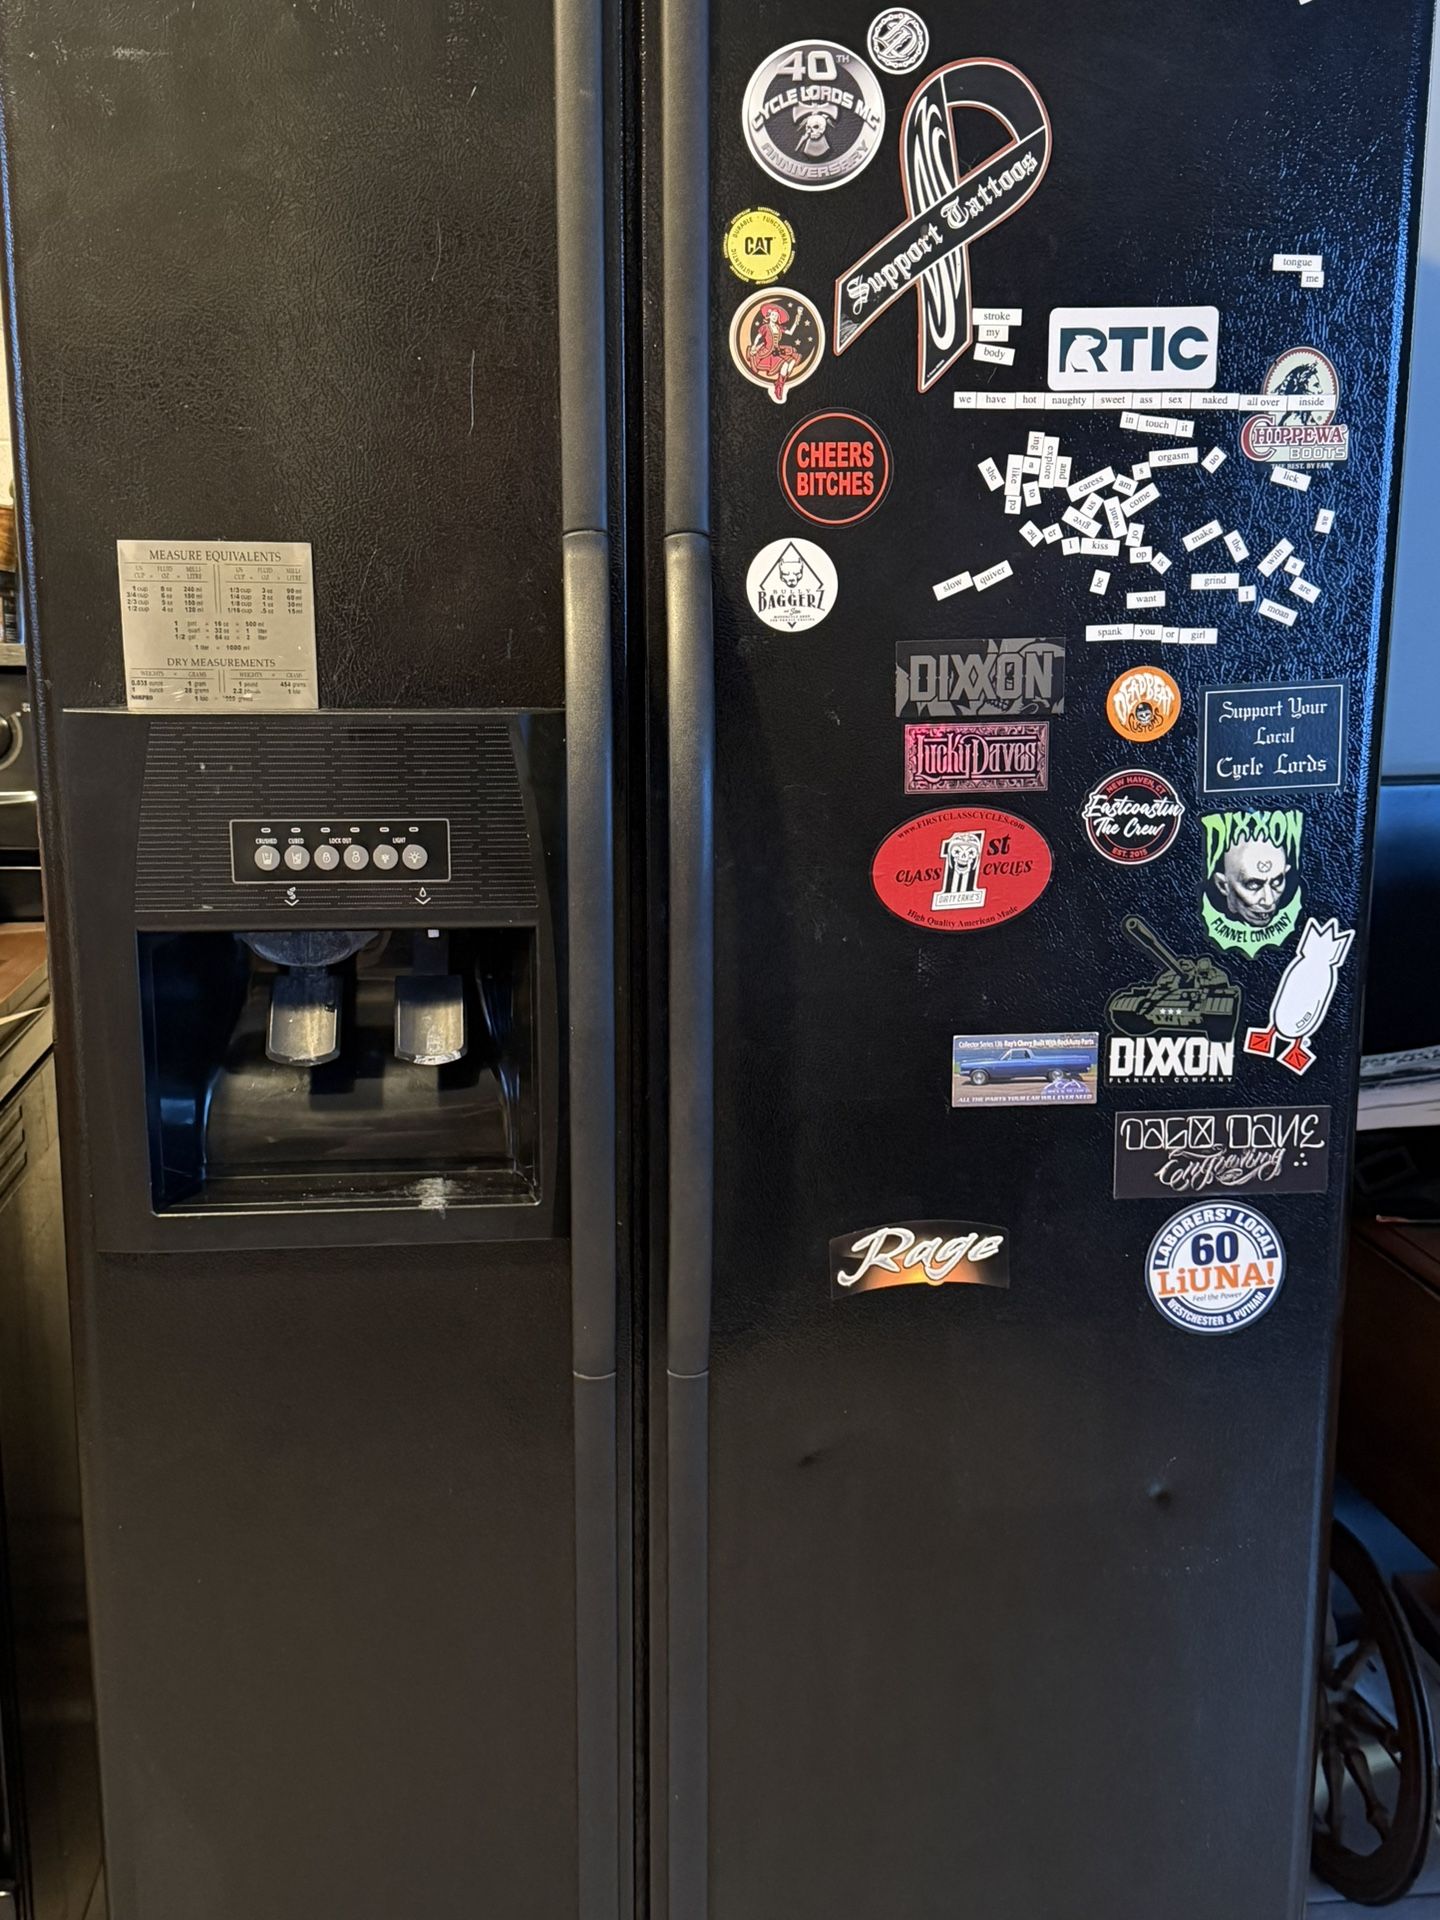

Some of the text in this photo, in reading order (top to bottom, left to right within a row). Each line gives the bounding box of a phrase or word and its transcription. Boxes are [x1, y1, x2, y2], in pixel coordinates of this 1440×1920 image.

[751, 85, 880, 131] CYCLE LORDS MC
[762, 139, 869, 178] ANNIVERSARY
[733, 217, 753, 238] DURABLE
[763, 215, 788, 245] FUNCTIONAL
[847, 151, 1039, 315] Support Tattoos
[745, 237, 773, 255] CAT
[1283, 258, 1313, 269] tongue
[984, 311, 1011, 321] stroke
[986, 329, 1000, 338] my
[984, 348, 1006, 360] body
[1059, 326, 1209, 373] RTIC
[959, 396, 972, 404] we
[986, 394, 1006, 404] have
[1022, 395, 1037, 404] hot
[1052, 395, 1086, 407] naughty
[1101, 395, 1125, 404] sweet
[1139, 396, 1153, 404] ass
[1168, 396, 1183, 404] sex
[1202, 394, 1228, 404] naked
[1247, 398, 1258, 406] all
[1299, 397, 1325, 406] inside
[1125, 416, 1188, 432] in touch it
[1031, 436, 1041, 451] ing
[1241, 414, 1344, 462] CHIPPEWA
[796, 441, 875, 469] CHEERS
[1044, 445, 1054, 480] explore
[1157, 451, 1190, 463] orgasm
[1289, 446, 1348, 461] BOOTS
[985, 466, 997, 482] she
[1011, 467, 1020, 485] like
[1059, 463, 1067, 480] and
[1283, 471, 1300, 483] lick
[796, 471, 874, 496] BITCHES
[1078, 475, 1104, 492] caress
[1118, 480, 1132, 490] am
[1029, 488, 1036, 498] to
[1129, 491, 1151, 509] come
[1072, 516, 1092, 529] give
[1109, 507, 1120, 529] want
[1048, 529, 1057, 537] er
[1191, 526, 1215, 544] make
[1092, 540, 1109, 549] kiss
[1231, 538, 1242, 553] the
[149, 550, 282, 563] MEASURE EQUIVALENTS
[1157, 556, 1166, 567] is
[1267, 547, 1284, 565] with
[942, 566, 1006, 592] slow quiver
[1203, 575, 1227, 587] grind
[1298, 583, 1311, 594] are
[758, 589, 825, 613] BAGGERZ
[1136, 594, 1157, 603] want
[1266, 603, 1290, 619] moan
[1097, 627, 1123, 638] spank
[1140, 628, 1155, 637] you
[1191, 630, 1206, 640] girl
[167, 657, 276, 668] DRY MEASUREMENTS
[909, 652, 1054, 702] DIXXON
[1218, 697, 1328, 723] Support Your
[1128, 707, 1164, 733] CUSTOMS
[1253, 726, 1295, 745] Local
[914, 733, 1036, 783] Lucky Daves
[1216, 753, 1328, 781] Cycle Lords
[1106, 778, 1125, 793] NEW
[1155, 785, 1166, 795] CT
[897, 811, 1026, 839] www.FIRSTCLASSCYCLES.com
[1093, 816, 1166, 838] The Crew
[1201, 810, 1303, 880] DIXXON
[896, 859, 1034, 887] CLASS CYCLES
[907, 905, 1018, 928] High Quality American Made
[1210, 912, 1292, 943] FLANNEL COMPANY
[1109, 1037, 1235, 1076] DIXXON
[1155, 1208, 1276, 1266] LABORERS' LOCAL
[837, 1227, 1004, 1287] Rage
[1191, 1231, 1239, 1266] 60
[1193, 1292, 1242, 1302] Feel the Power
[1167, 1291, 1267, 1326] WESTCHESTER & PUTNAM
